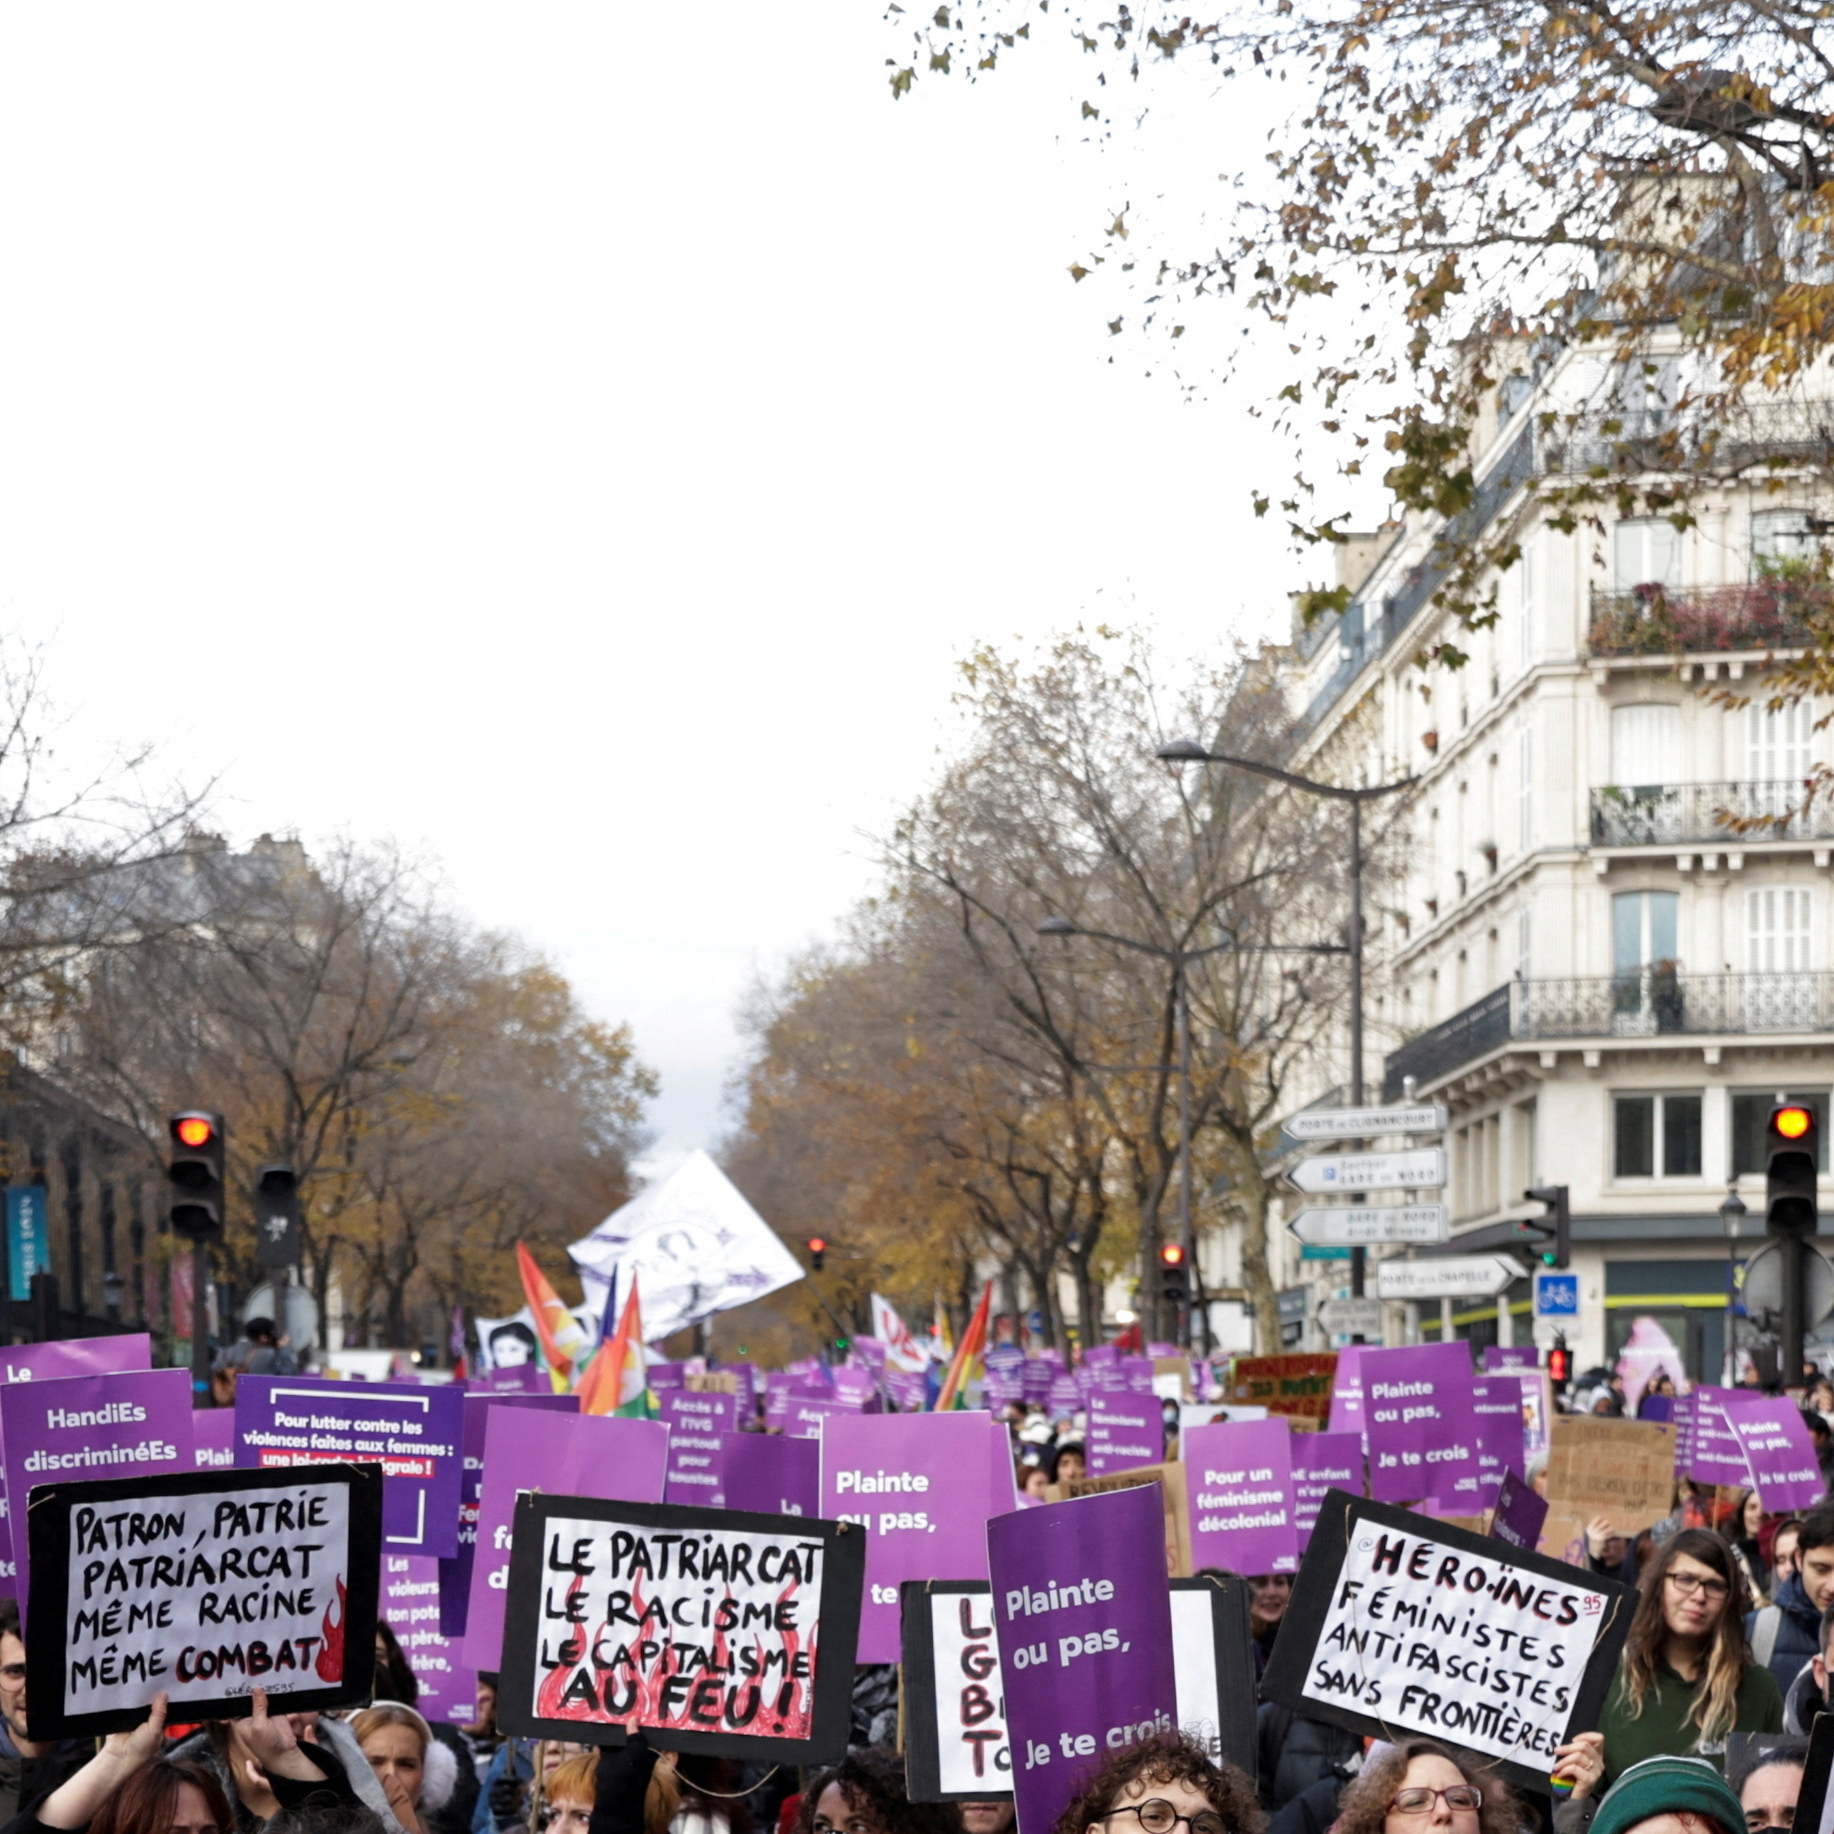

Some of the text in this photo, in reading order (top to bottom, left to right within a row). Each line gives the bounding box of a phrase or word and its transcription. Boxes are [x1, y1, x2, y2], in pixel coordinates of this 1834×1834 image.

[7, 1364, 32, 1382] Le
[1371, 1380, 1434, 1400] Plainte
[47, 1402, 147, 1429] HandiEs
[671, 1398, 711, 1414] Accès
[1091, 1398, 1105, 1410] Le
[1374, 1404, 1441, 1423] ou pas,
[274, 1411, 423, 1436] Pour lutter contre les
[1091, 1413, 1146, 1428] féminisme
[1738, 1421, 1781, 1435] Plainte
[243, 1430, 446, 1457] violences faites aux femmes
[670, 1437, 721, 1451] partout
[1748, 1440, 1765, 1450] ou
[23, 1440, 177, 1472] discriminéEs
[262, 1453, 291, 1467] une
[677, 1455, 711, 1468] pour
[1378, 1444, 1470, 1468] Je te crois
[668, 1471, 719, 1486] toustes
[836, 1469, 930, 1495] Plainte
[1204, 1467, 1273, 1486] Pour un
[1309, 1468, 1352, 1481] enfant
[1789, 1469, 1816, 1483] crois
[781, 1499, 802, 1516] La
[1196, 1490, 1284, 1510] féminisme
[213, 1489, 330, 1540] PATRIE
[879, 1512, 938, 1535] pas,
[1197, 1509, 1288, 1533] décolonial
[387, 1557, 409, 1574] Les
[548, 1533, 595, 1576] LE
[610, 1530, 824, 1587] PATRIARCAT
[83, 1544, 325, 1601] PATRIARCAT
[870, 1583, 898, 1605] te
[1006, 1576, 1115, 1621] Plainte
[71, 1582, 317, 1645] MÊME RACINE
[386, 1607, 409, 1622] ton
[545, 1587, 799, 1632] LE RACISME
[1338, 1580, 1566, 1669] FÉMINISTES
[541, 1637, 811, 1679] LE CAPITALISME
[1013, 1626, 1131, 1671] ou pas,
[71, 1635, 322, 1695] MÊME COMBAT
[1324, 1621, 1570, 1714] ANTIFASCISTES
[557, 1666, 638, 1717] AU
[658, 1676, 761, 1730] FEU
[1314, 1659, 1561, 1758] SANS FRONTIÈRES
[1025, 1708, 1171, 1770] Je te crois
